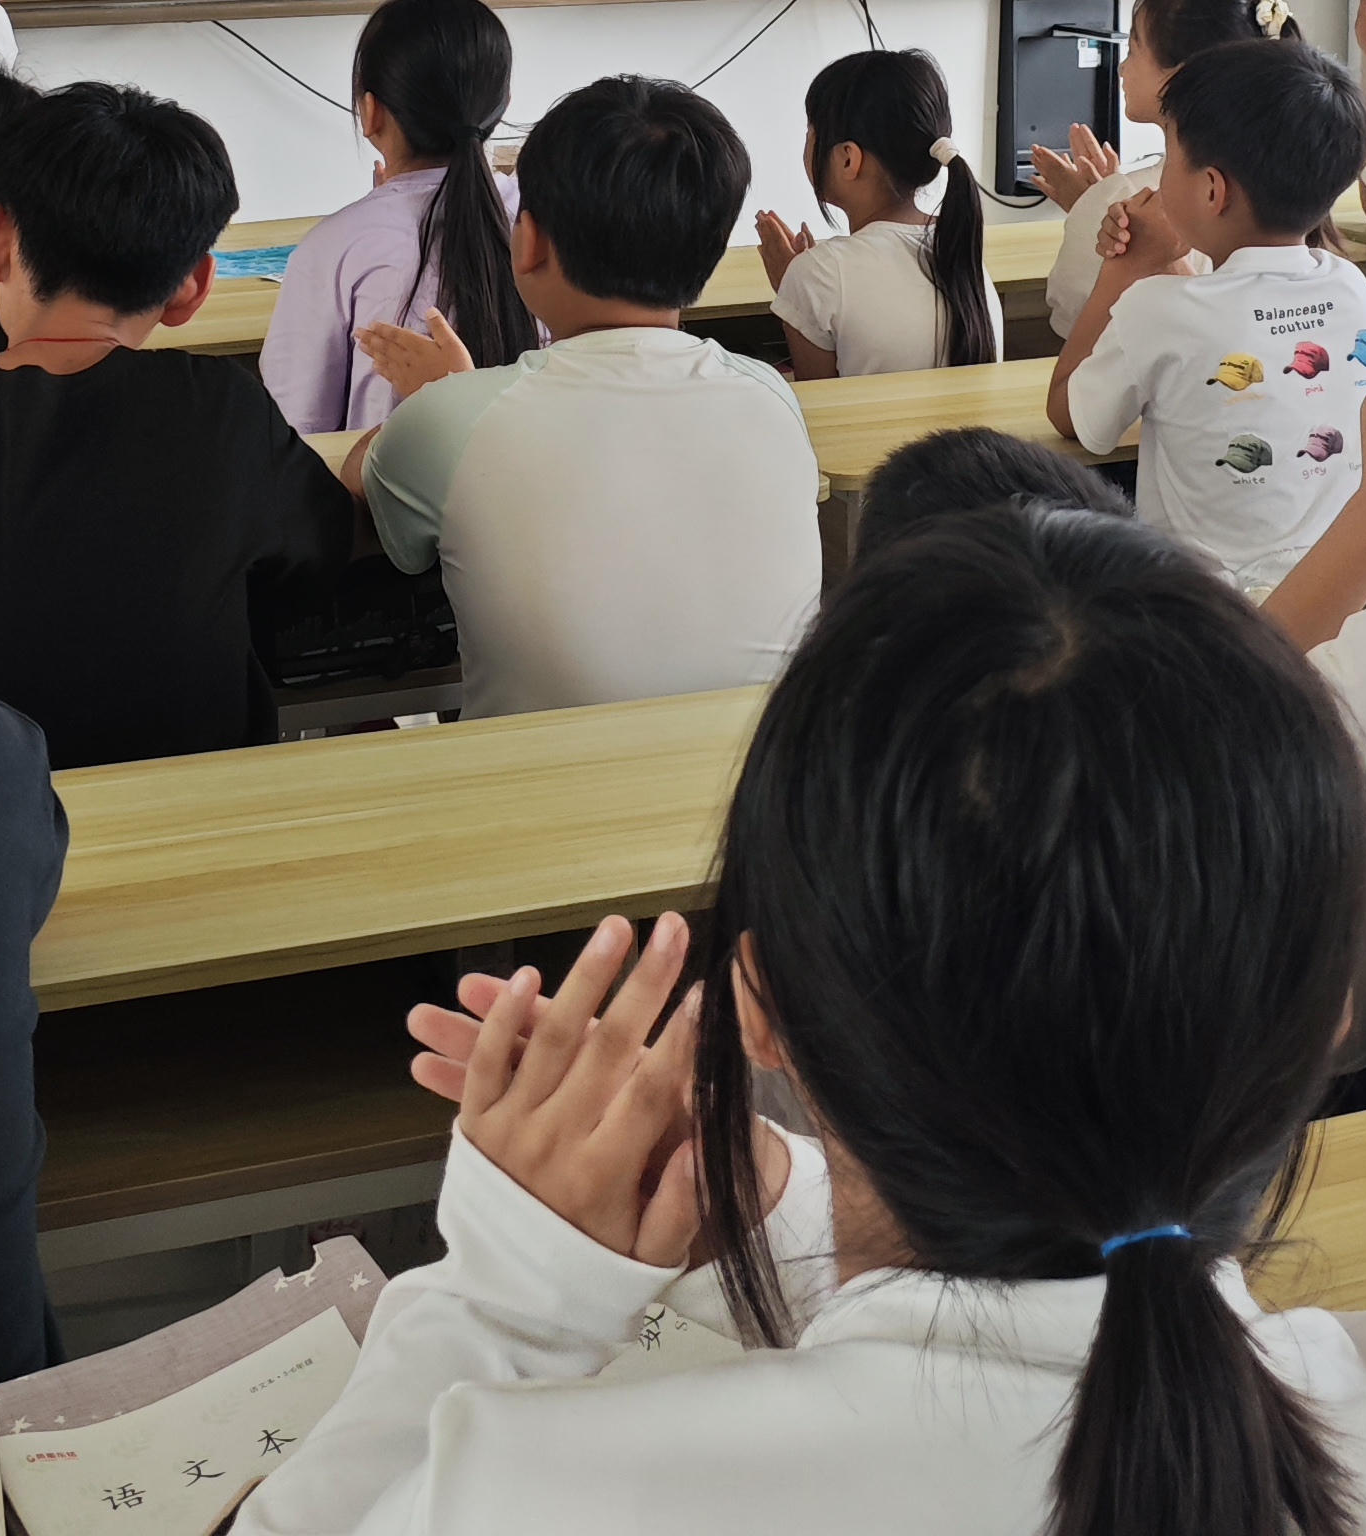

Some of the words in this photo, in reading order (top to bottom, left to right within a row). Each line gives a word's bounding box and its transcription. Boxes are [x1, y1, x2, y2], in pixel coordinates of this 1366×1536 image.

[1254, 301, 1334, 322] Balanceage
[1270, 318, 1325, 336] couture
[102, 1429, 298, 1511] 语文本
